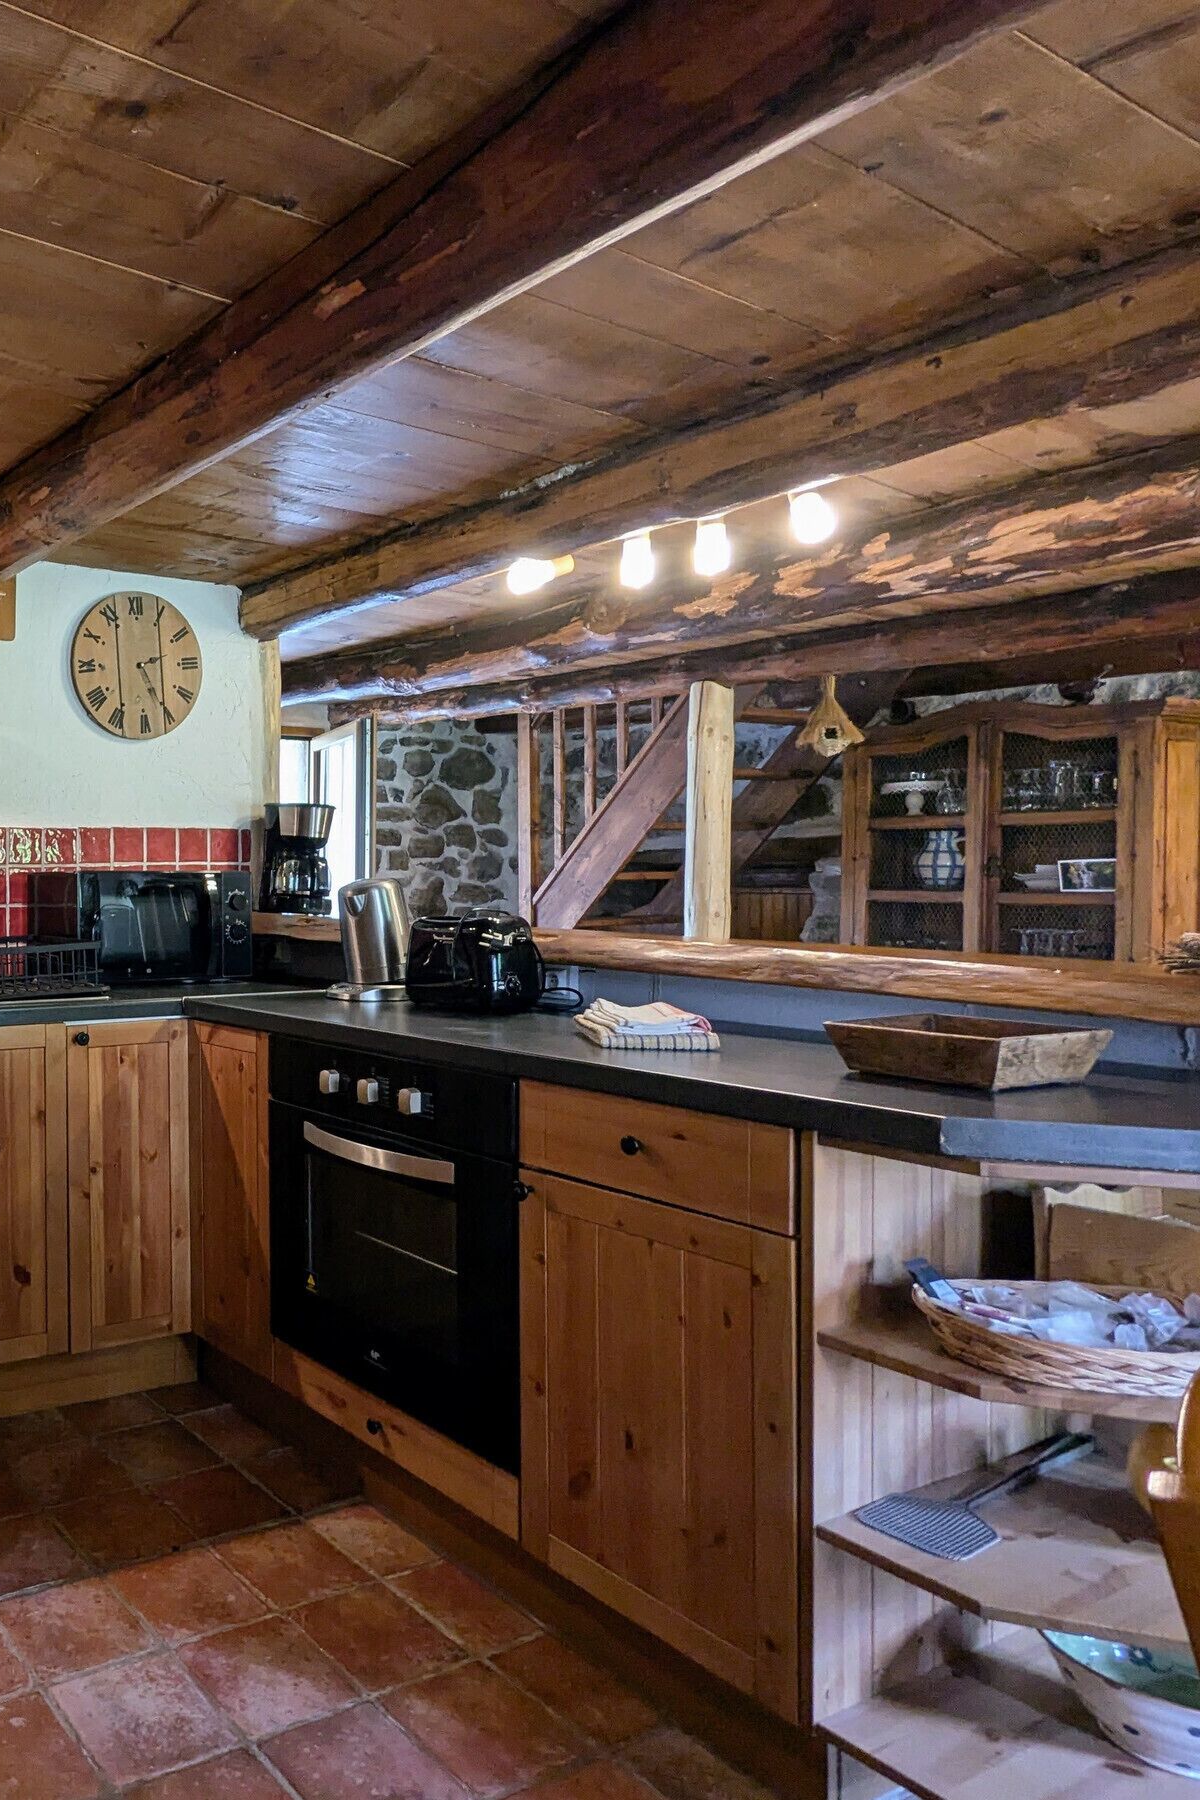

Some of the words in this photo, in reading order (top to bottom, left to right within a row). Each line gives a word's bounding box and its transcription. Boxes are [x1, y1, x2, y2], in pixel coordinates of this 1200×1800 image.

[99, 604, 118, 626] XI
[128, 596, 143, 615] XII
[83, 627, 100, 643] X
[172, 626, 189, 642] II
[78, 658, 95, 673] IX
[181, 657, 198, 670] III
[86, 685, 107, 712] VIII
[177, 686, 193, 703] IV
[108, 707, 125, 729] VII
[140, 714, 151, 734] VI
[163, 706, 175, 725] V
